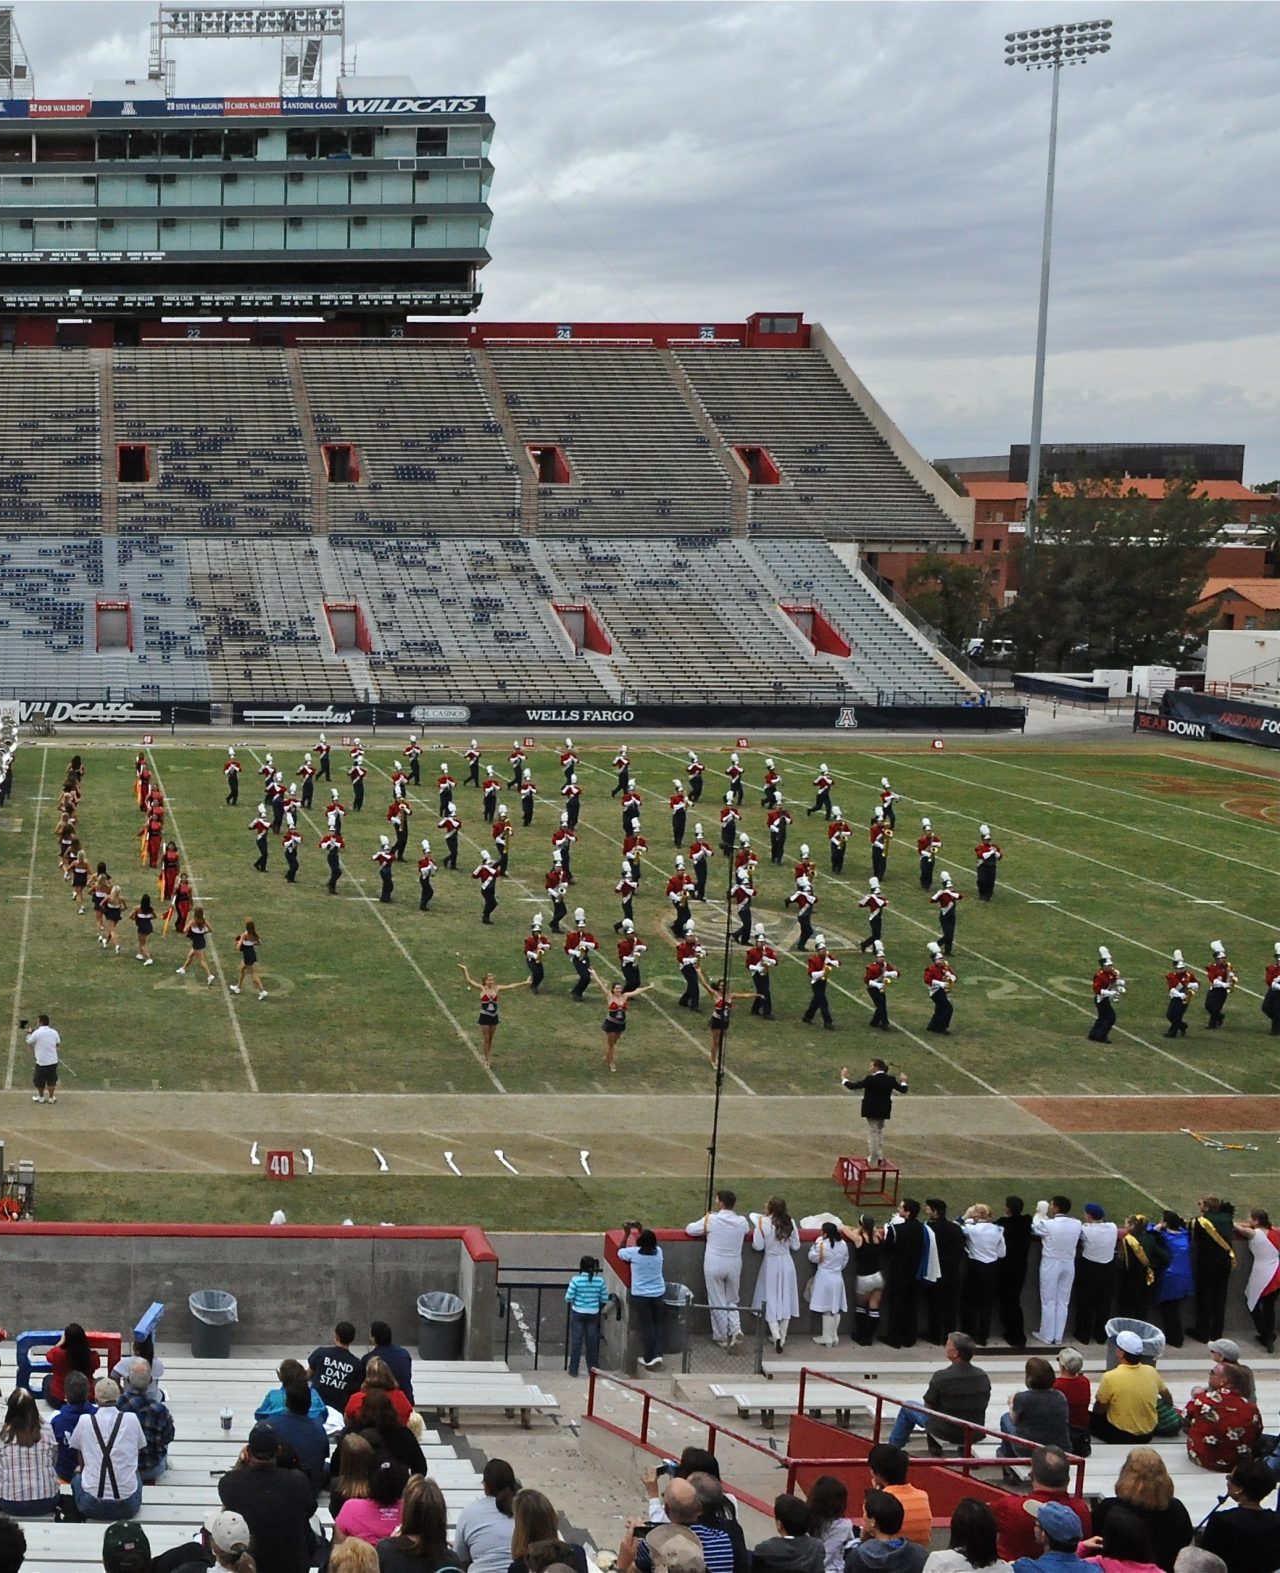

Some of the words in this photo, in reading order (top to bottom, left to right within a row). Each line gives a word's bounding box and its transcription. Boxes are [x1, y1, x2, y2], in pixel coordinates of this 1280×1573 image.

[53, 104, 84, 112] WALDROP
[224, 102, 230, 110] 11
[231, 102, 248, 110] CHRIS
[250, 102, 280, 110] McALISTER
[315, 102, 337, 110] CASON
[346, 98, 478, 112] WILDCATS
[188, 330, 200, 338] 22
[391, 329, 403, 338] 23
[558, 330, 570, 339] 24
[700, 331, 714, 340] 25
[526, 710, 579, 721] WELLS
[582, 710, 634, 722] FARGO
[836, 707, 857, 727] A
[1218, 712, 1262, 730] ARIZONA
[1139, 715, 1168, 730] BEAR
[1168, 720, 1205, 737] DOWN
[270, 1155, 290, 1175] 40
[323, 1357, 353, 1373] BAND
[325, 1367, 347, 1380] DAY
[320, 1374, 348, 1390] STAFF
